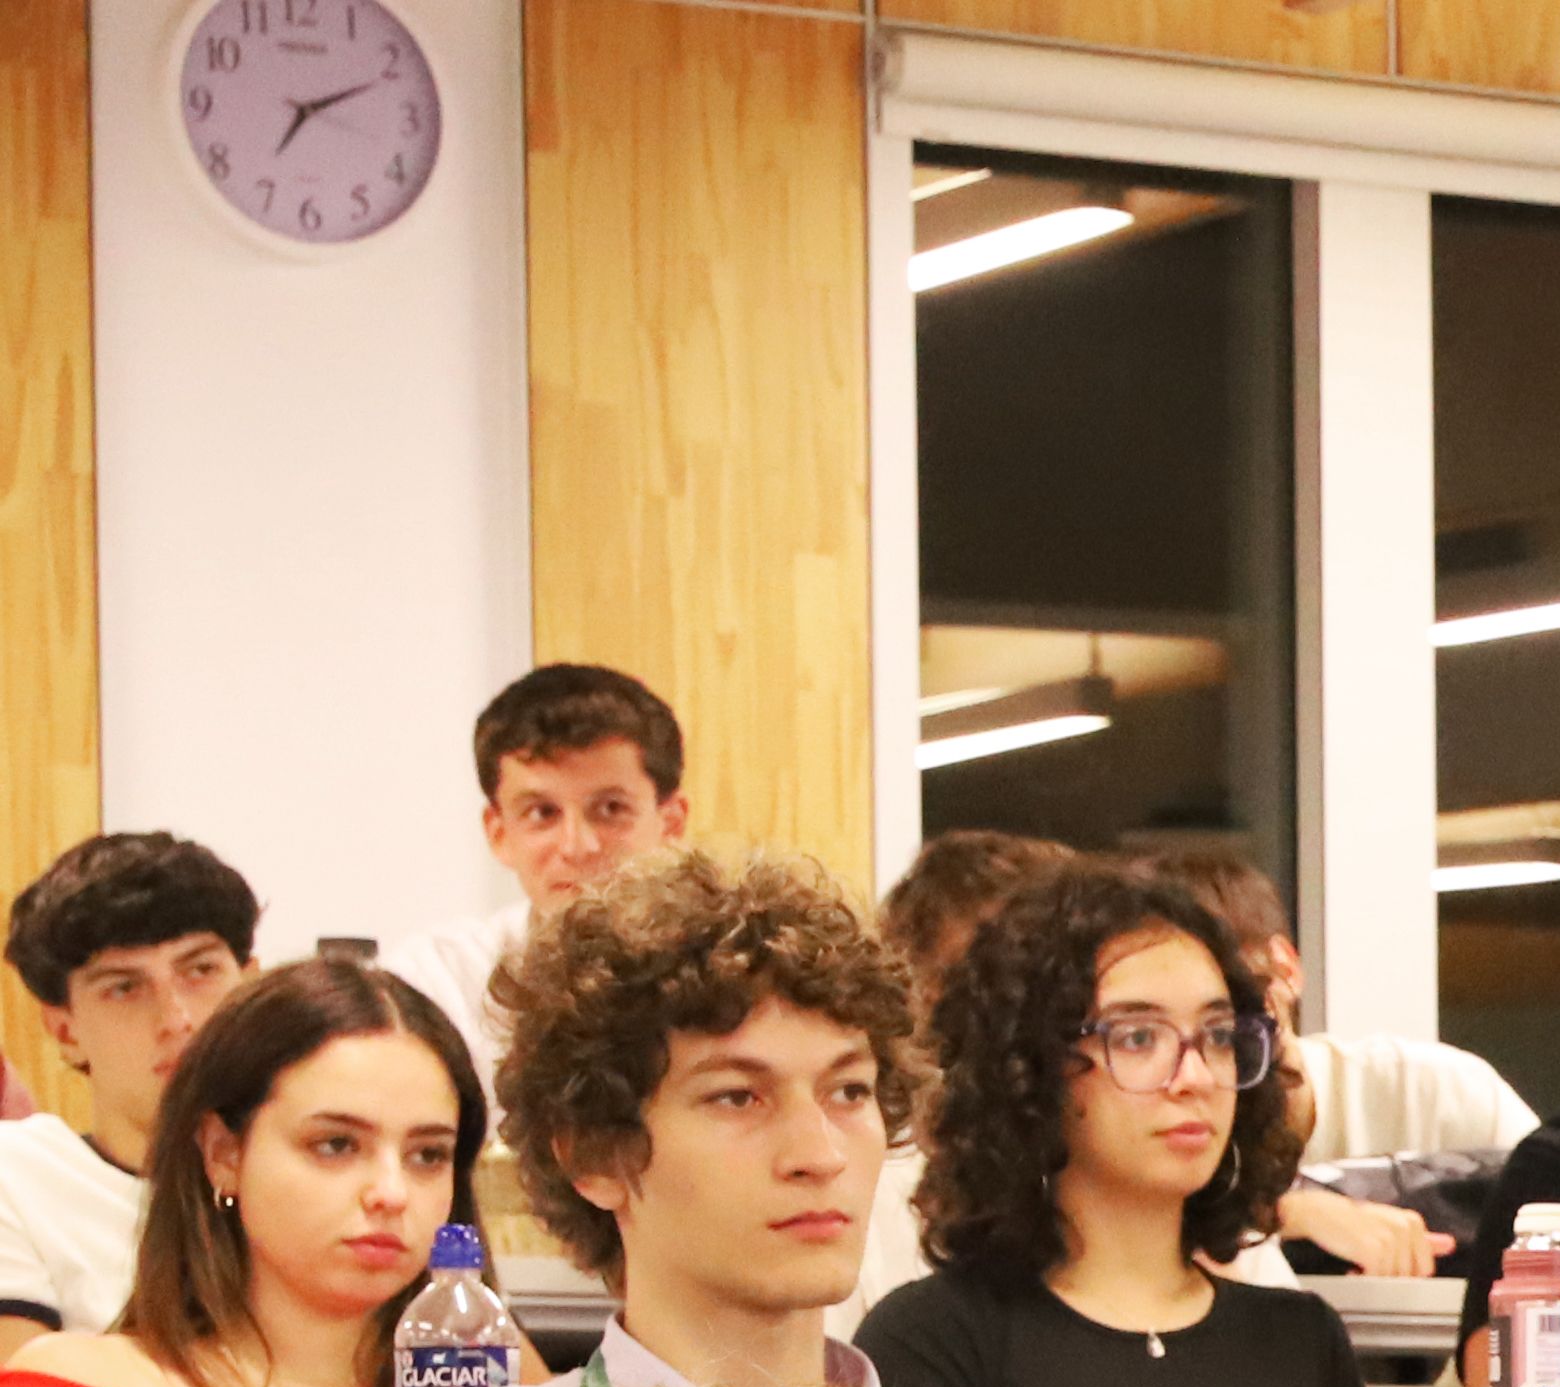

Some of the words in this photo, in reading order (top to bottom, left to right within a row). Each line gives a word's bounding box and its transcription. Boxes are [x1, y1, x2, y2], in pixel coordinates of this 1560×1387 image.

[241, 0, 268, 34] 11
[347, 4, 356, 40] 1
[207, 36, 241, 72] 10
[380, 42, 400, 81] 2
[189, 84, 213, 121] 9
[402, 102, 420, 138] 3
[208, 142, 230, 180] 8
[384, 151, 406, 184] 4
[257, 176, 276, 212] 7
[351, 184, 371, 220] 5
[299, 196, 322, 231] 6
[402, 1366, 487, 1387] GLACIAR
